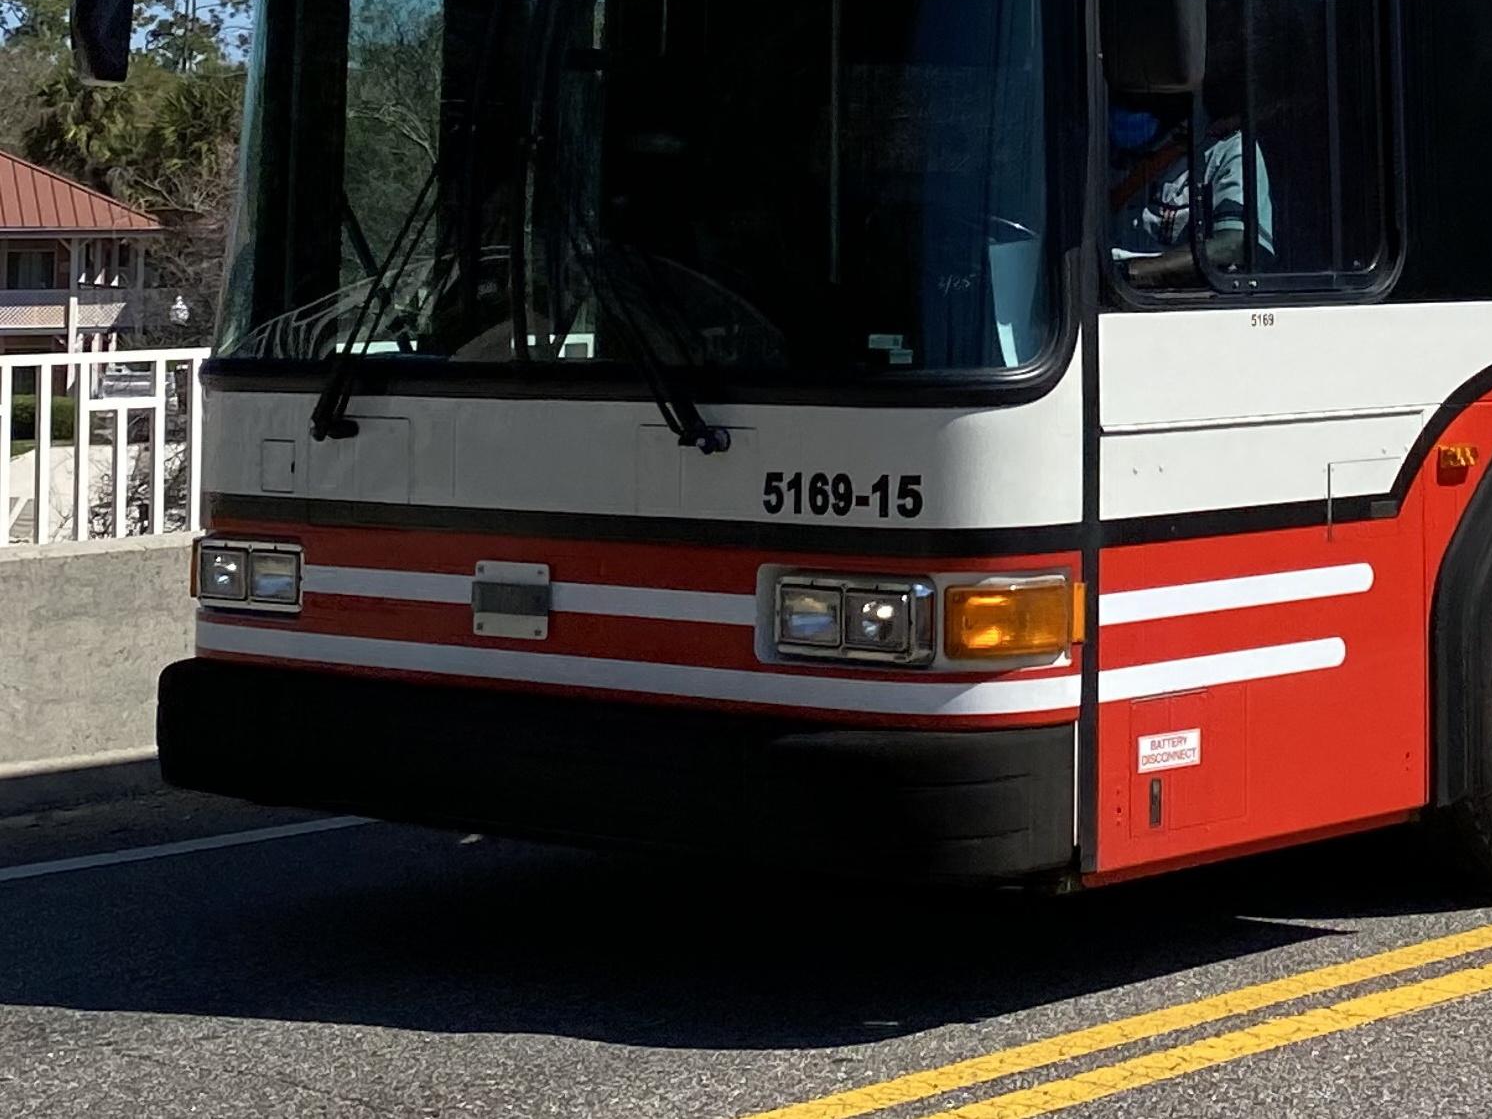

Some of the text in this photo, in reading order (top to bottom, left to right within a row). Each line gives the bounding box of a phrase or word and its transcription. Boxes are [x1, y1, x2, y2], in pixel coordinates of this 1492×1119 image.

[1251, 313, 1275, 327] 5169
[763, 472, 924, 518] 5169-15
[1150, 736, 1188, 750] BATTERY
[1141, 747, 1198, 766] DISCONNECT
